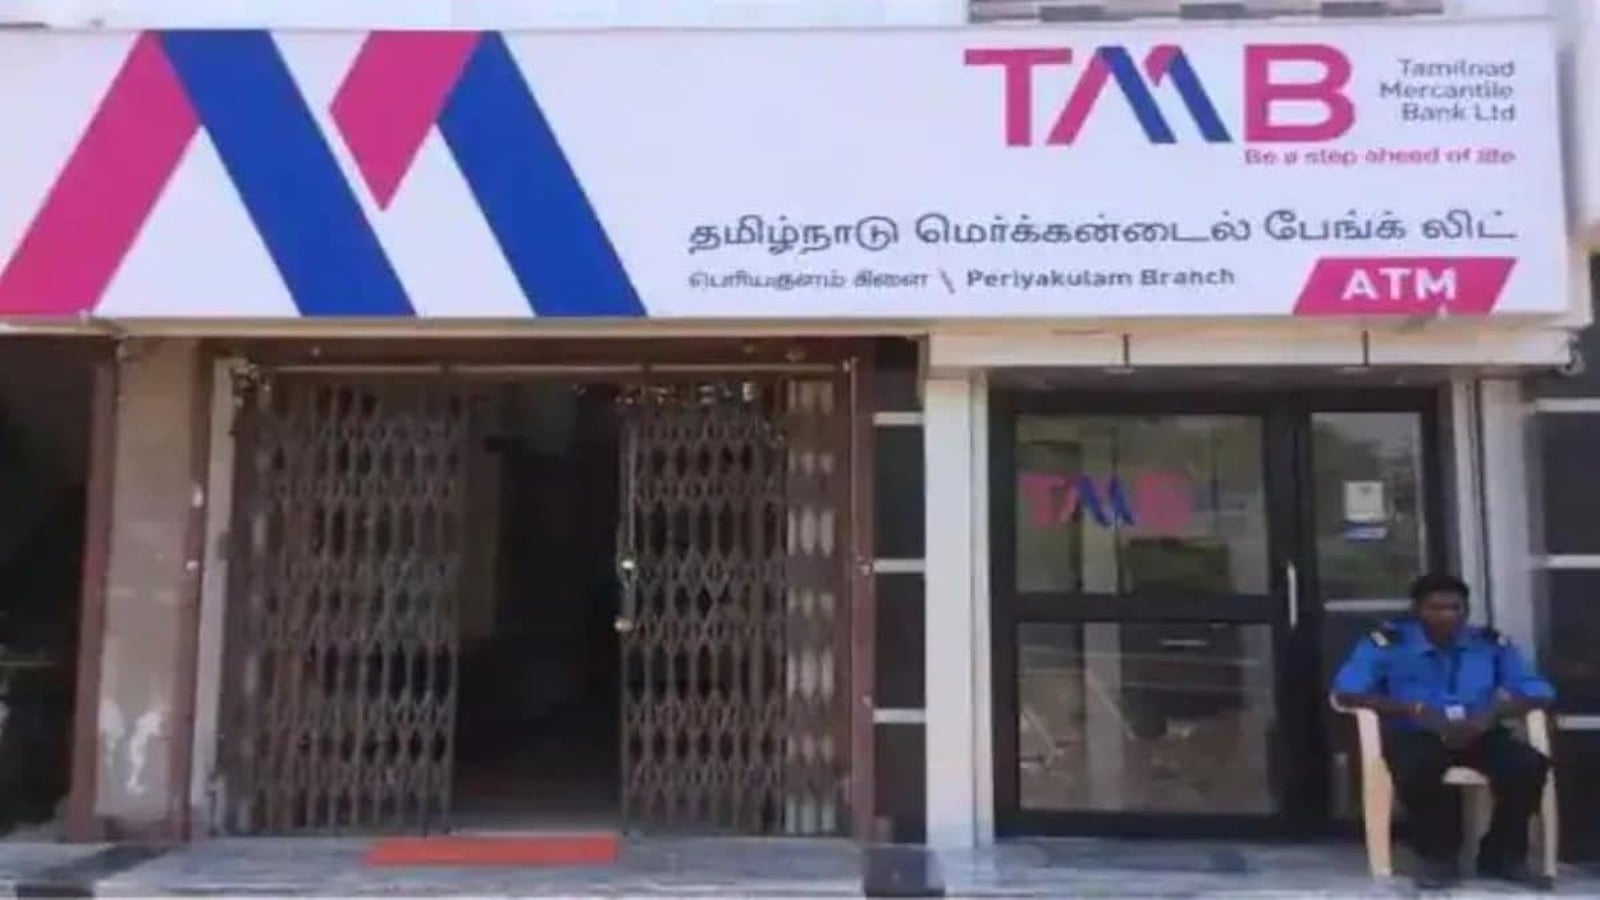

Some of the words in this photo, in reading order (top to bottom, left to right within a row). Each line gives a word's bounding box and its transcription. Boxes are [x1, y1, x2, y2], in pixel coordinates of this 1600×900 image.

[1398, 58, 1515, 78] Tamilnad
[964, 43, 1356, 148] TMB
[1380, 81, 1514, 98] Mercantile
[1401, 102, 1465, 121] Bank
[1474, 103, 1516, 121] Ltd
[1245, 149, 1275, 164] Be
[1305, 149, 1357, 166] step
[1365, 148, 1439, 163] ahead
[1446, 149, 1470, 163] of
[688, 214, 900, 253] தமிழ்நாடு
[1421, 208, 1518, 240] லிட்
[966, 268, 1133, 291] Periyakulam
[1139, 267, 1235, 287] Branch
[1342, 268, 1456, 301] ATM
